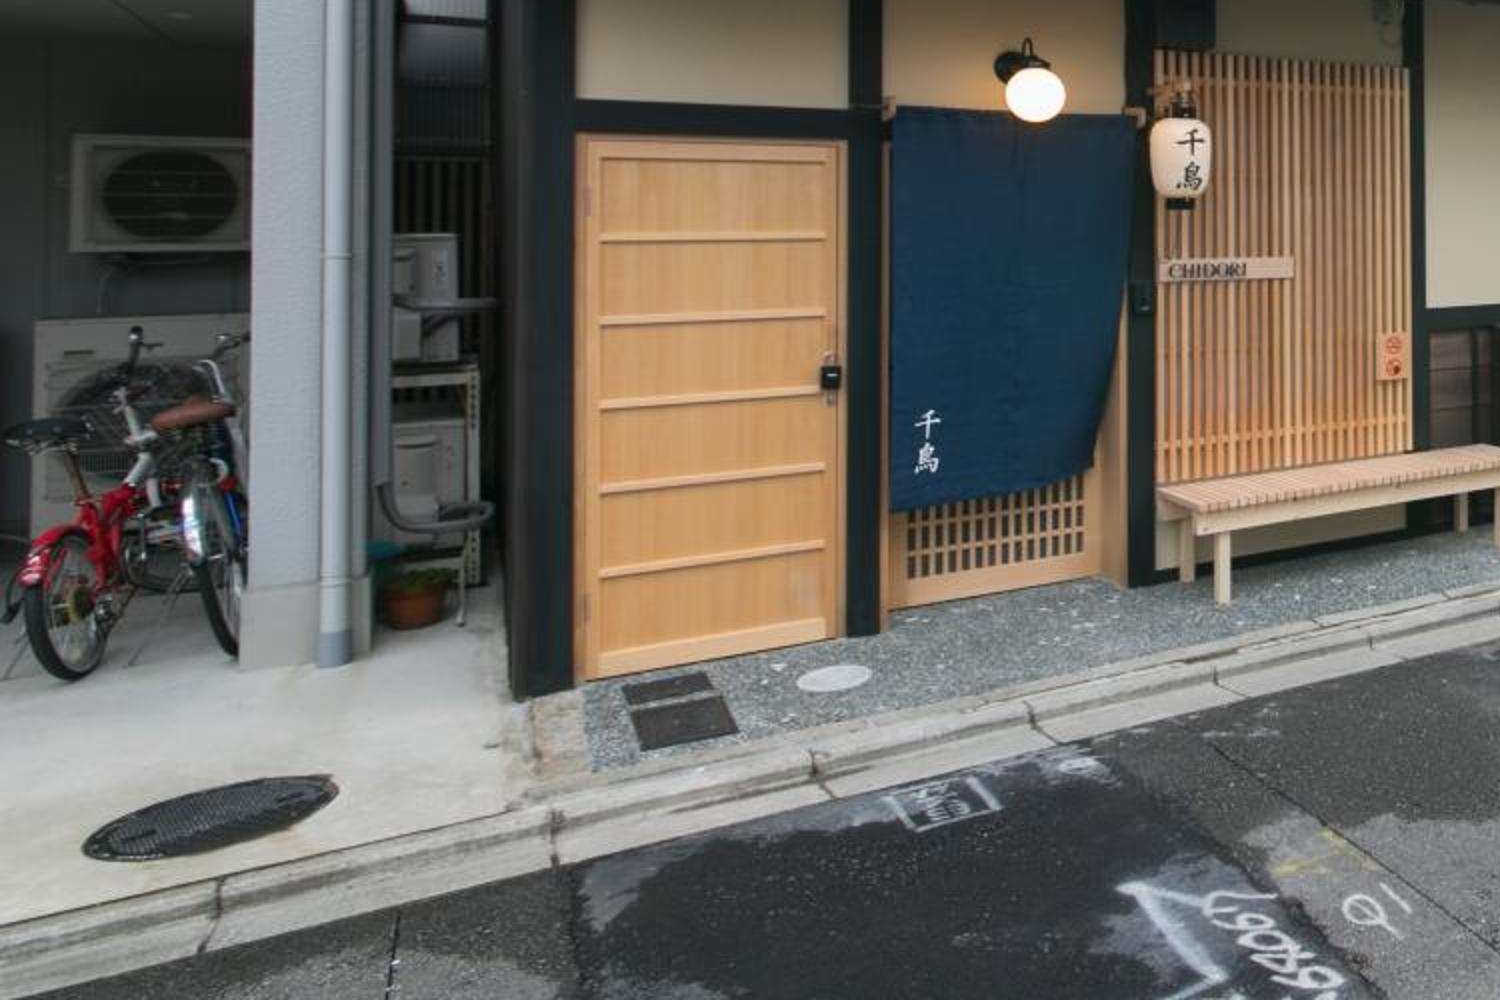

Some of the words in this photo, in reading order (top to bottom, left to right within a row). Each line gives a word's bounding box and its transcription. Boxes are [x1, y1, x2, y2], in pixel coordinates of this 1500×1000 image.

[1175, 128, 1205, 190] 千鳥
[1168, 263, 1248, 280] CHIDORI
[913, 408, 942, 475] 千鳥
